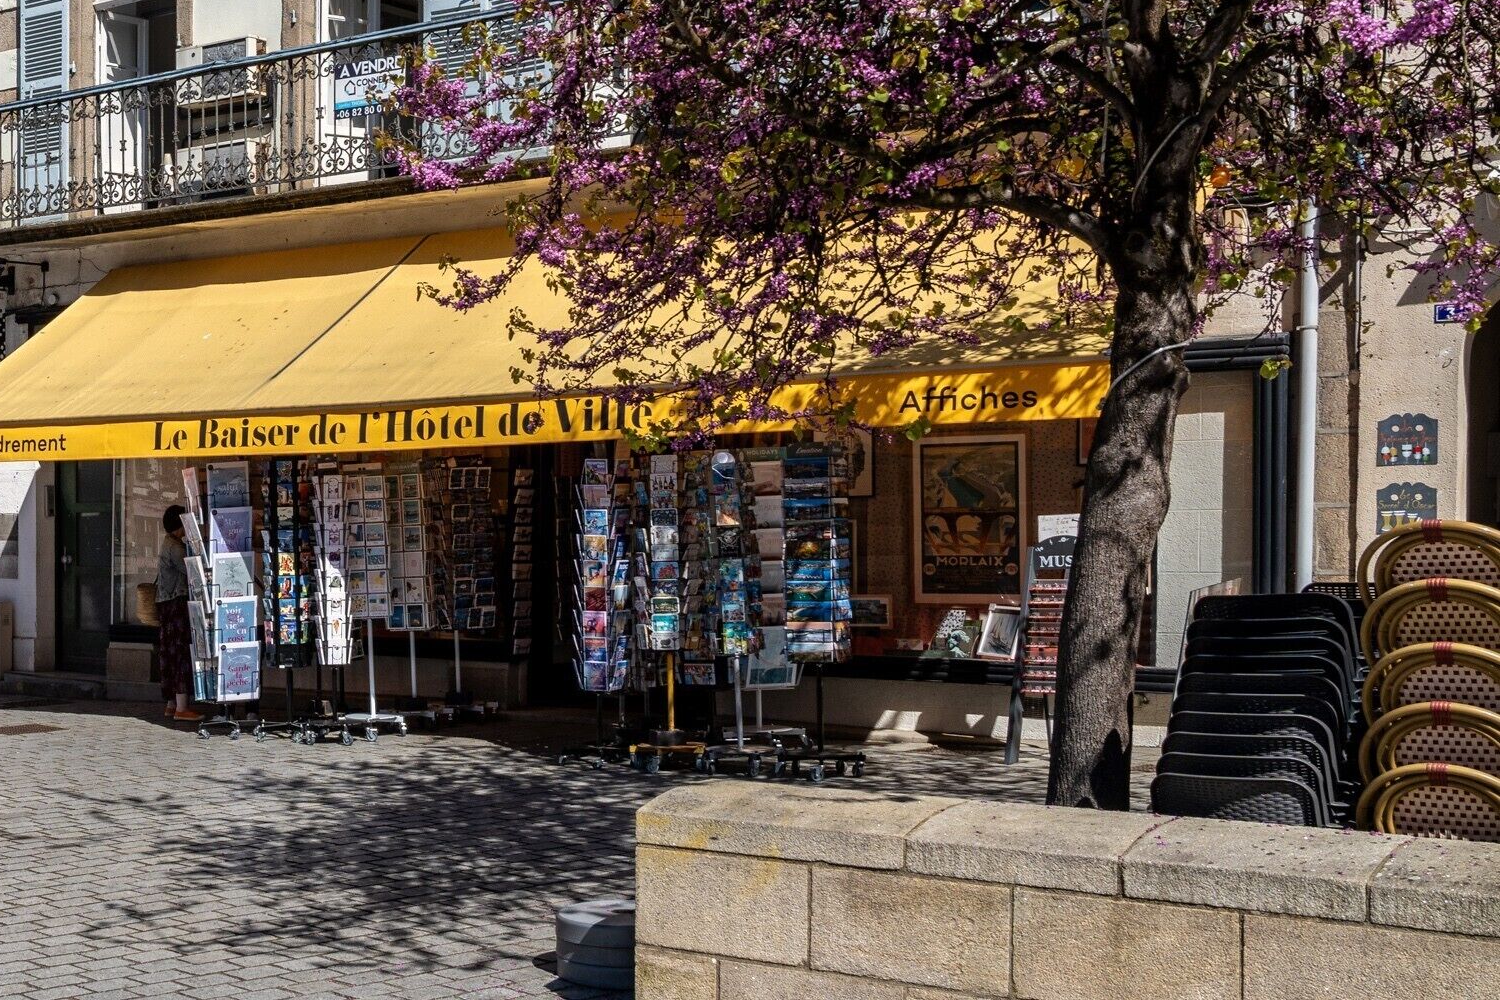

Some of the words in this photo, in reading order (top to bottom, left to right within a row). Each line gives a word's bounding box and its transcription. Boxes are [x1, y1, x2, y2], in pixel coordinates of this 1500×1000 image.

[339, 109, 350, 119] 06
[352, 107, 362, 117] 82
[364, 105, 375, 115] 80
[898, 385, 1038, 414] Affiches
[153, 421, 188, 450] Le
[197, 418, 300, 449] Baiser
[309, 413, 346, 445] de
[554, 397, 652, 434] Ville
[936, 556, 1003, 566] MORLAIX
[1039, 555, 1073, 568] MUS
[225, 605, 241, 614] voir
